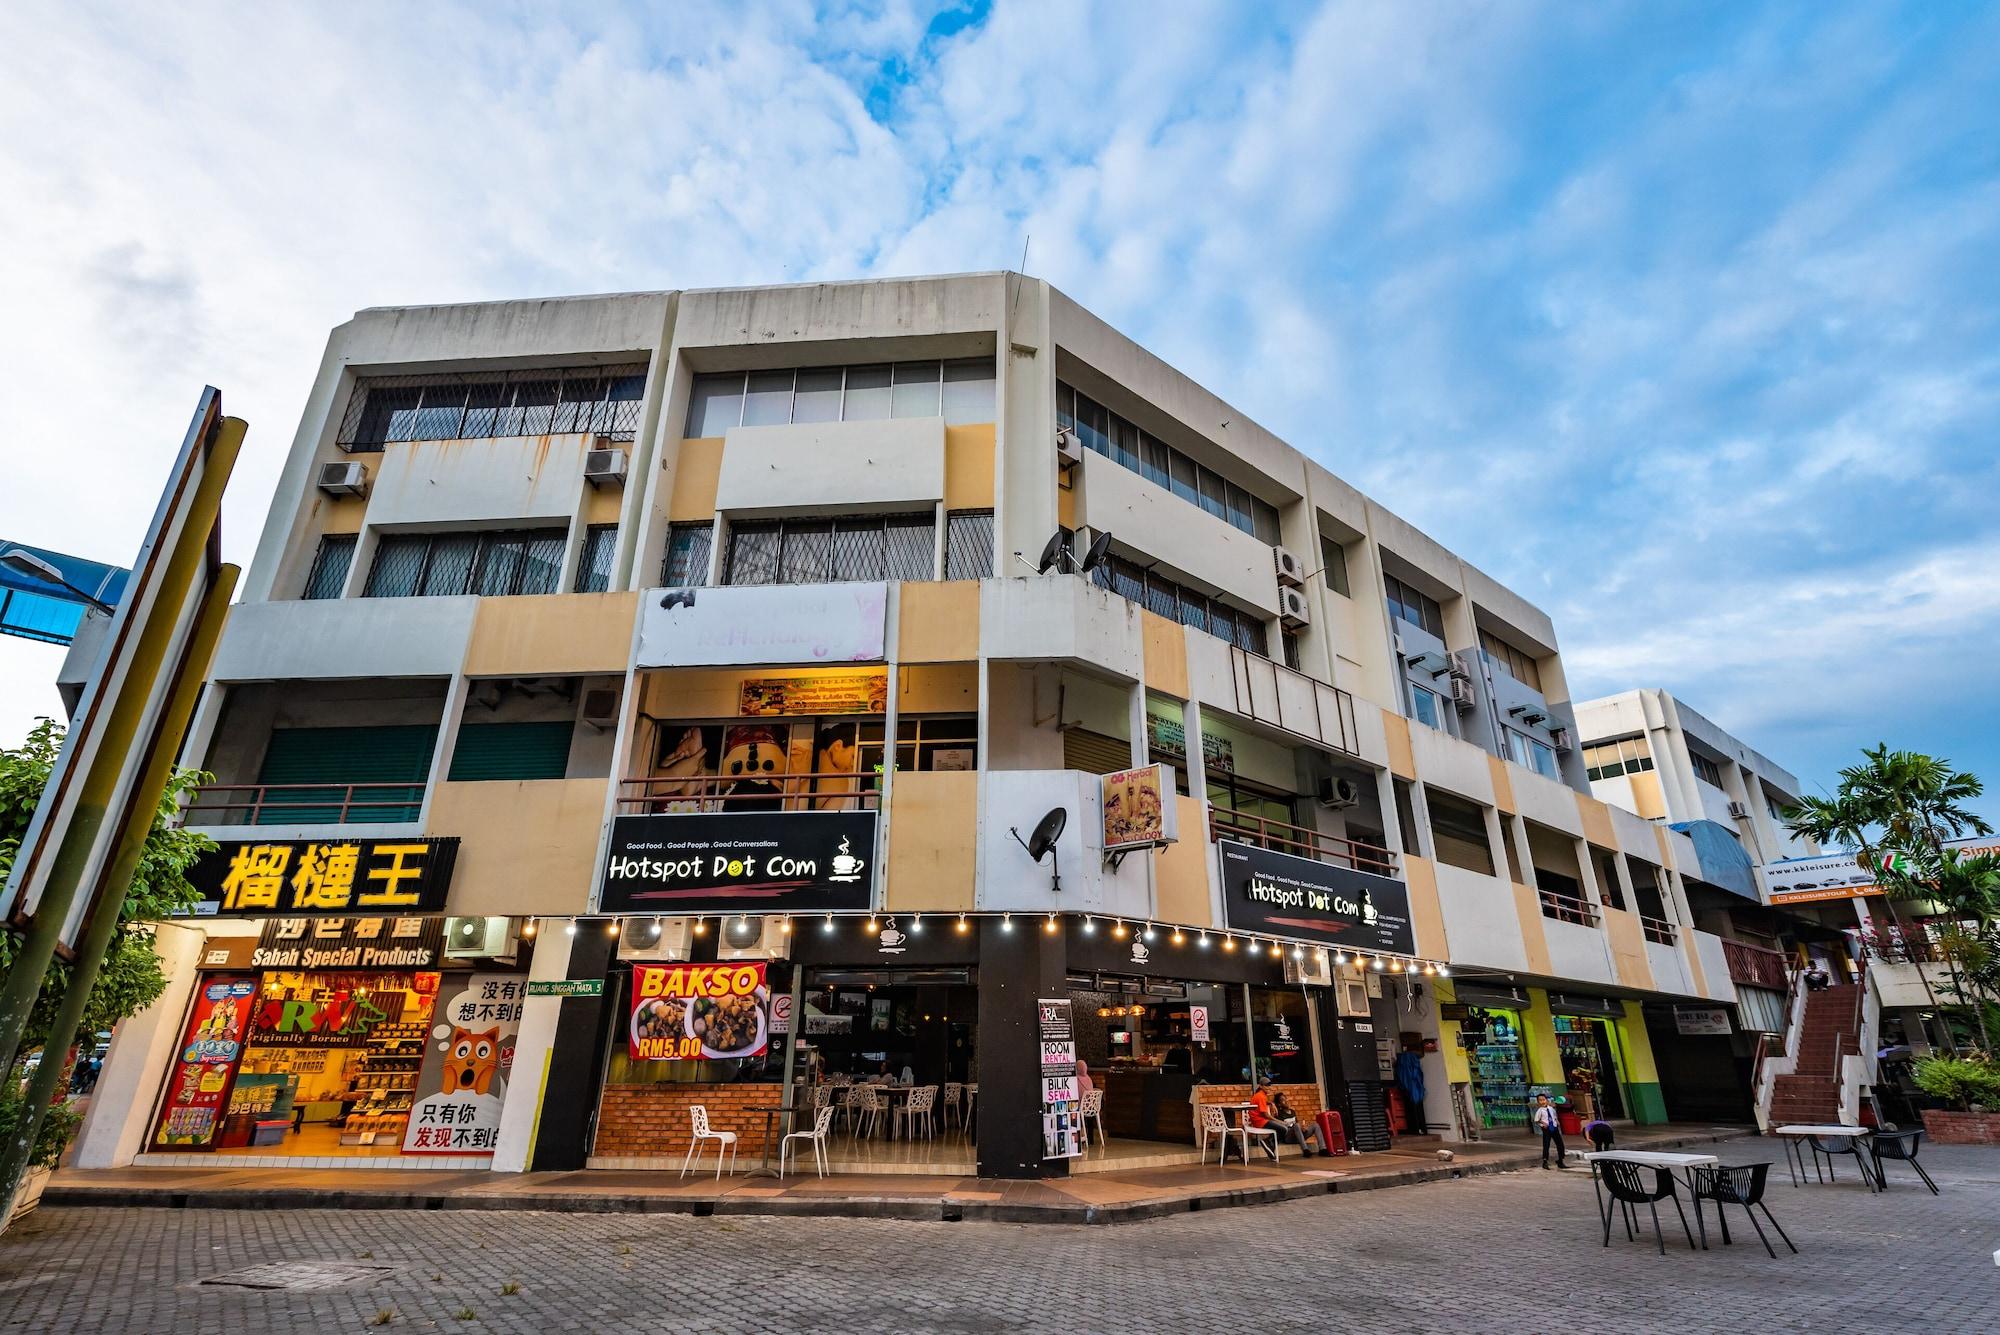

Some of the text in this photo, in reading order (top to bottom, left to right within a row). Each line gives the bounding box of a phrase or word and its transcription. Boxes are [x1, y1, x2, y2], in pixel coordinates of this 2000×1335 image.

[1127, 768, 1153, 783] Herbal
[646, 842, 663, 850] Food
[687, 841, 710, 850] People
[733, 840, 778, 848] Conversations
[609, 855, 817, 882] Hotspot Dot Com
[1767, 858, 1857, 877] www.kkleisure.co
[1252, 878, 1360, 916] Hotspot Dot Com
[1788, 889, 1848, 901] KKLEISURETOUR
[251, 947, 300, 967] Sabah
[301, 946, 361, 968] Special
[364, 946, 432, 966] Products
[550, 983, 576, 993] SINGGAH
[576, 982, 593, 992] MATA
[596, 983, 602, 992] 5
[640, 966, 759, 998] BAKSO
[252, 1032, 350, 1045] riginally Borneo
[638, 1038, 702, 1058] RM5.00
[1044, 1042, 1070, 1054] ROOM
[1044, 1054, 1070, 1063] RENTAL
[1048, 1078, 1070, 1090] BILIK
[1048, 1090, 1072, 1101] SEWA
[419, 1104, 477, 1124] 只有你
